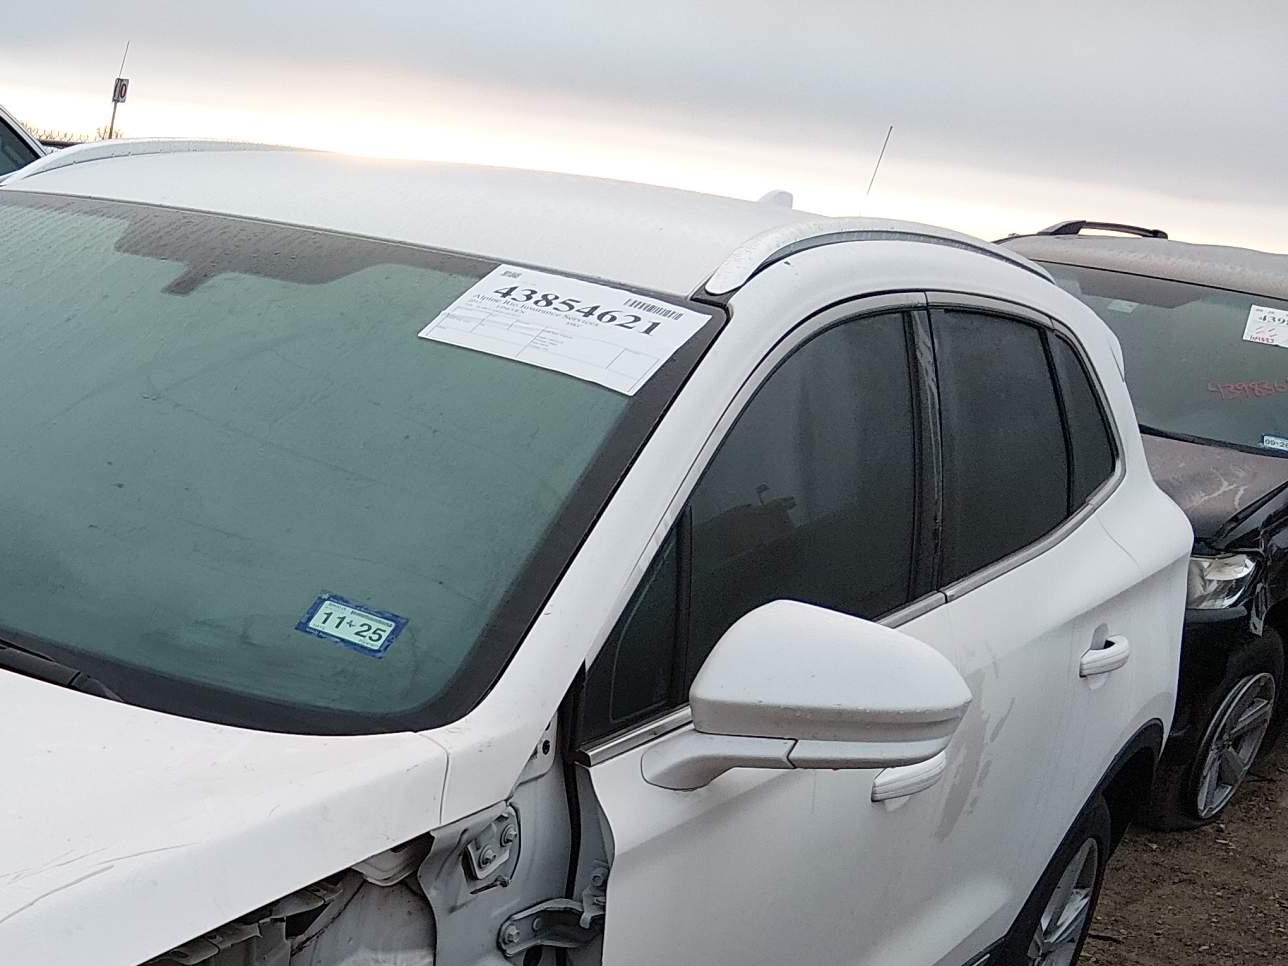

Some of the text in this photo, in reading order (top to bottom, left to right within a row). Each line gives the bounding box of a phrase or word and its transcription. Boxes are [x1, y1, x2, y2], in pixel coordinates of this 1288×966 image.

[494, 285, 662, 335] 43854621
[322, 611, 387, 642] 11 25
